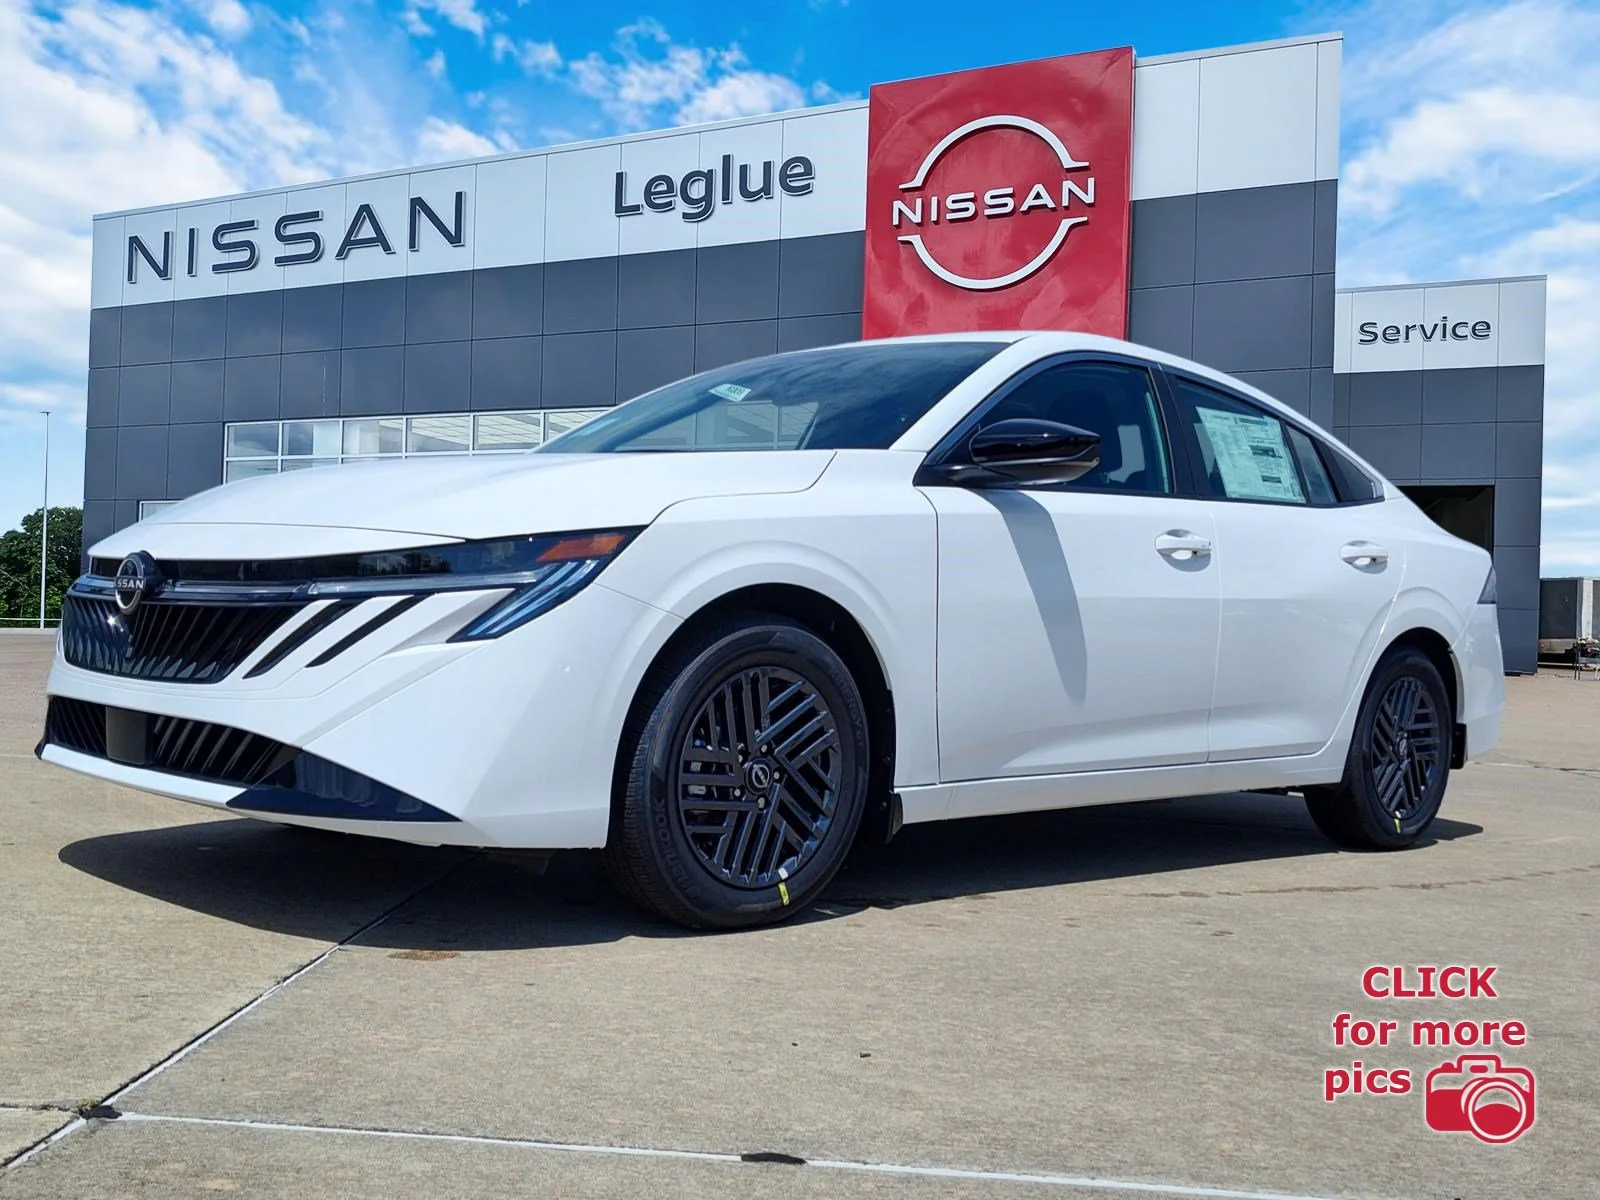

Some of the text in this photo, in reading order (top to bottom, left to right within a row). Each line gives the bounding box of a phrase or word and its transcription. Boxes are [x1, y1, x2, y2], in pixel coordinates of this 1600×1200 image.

[614, 154, 816, 222] Leglue
[892, 176, 1096, 227] NISSAN
[126, 190, 466, 284] NISSAN
[1358, 315, 1492, 345] Service
[116, 578, 144, 589] SSAN
